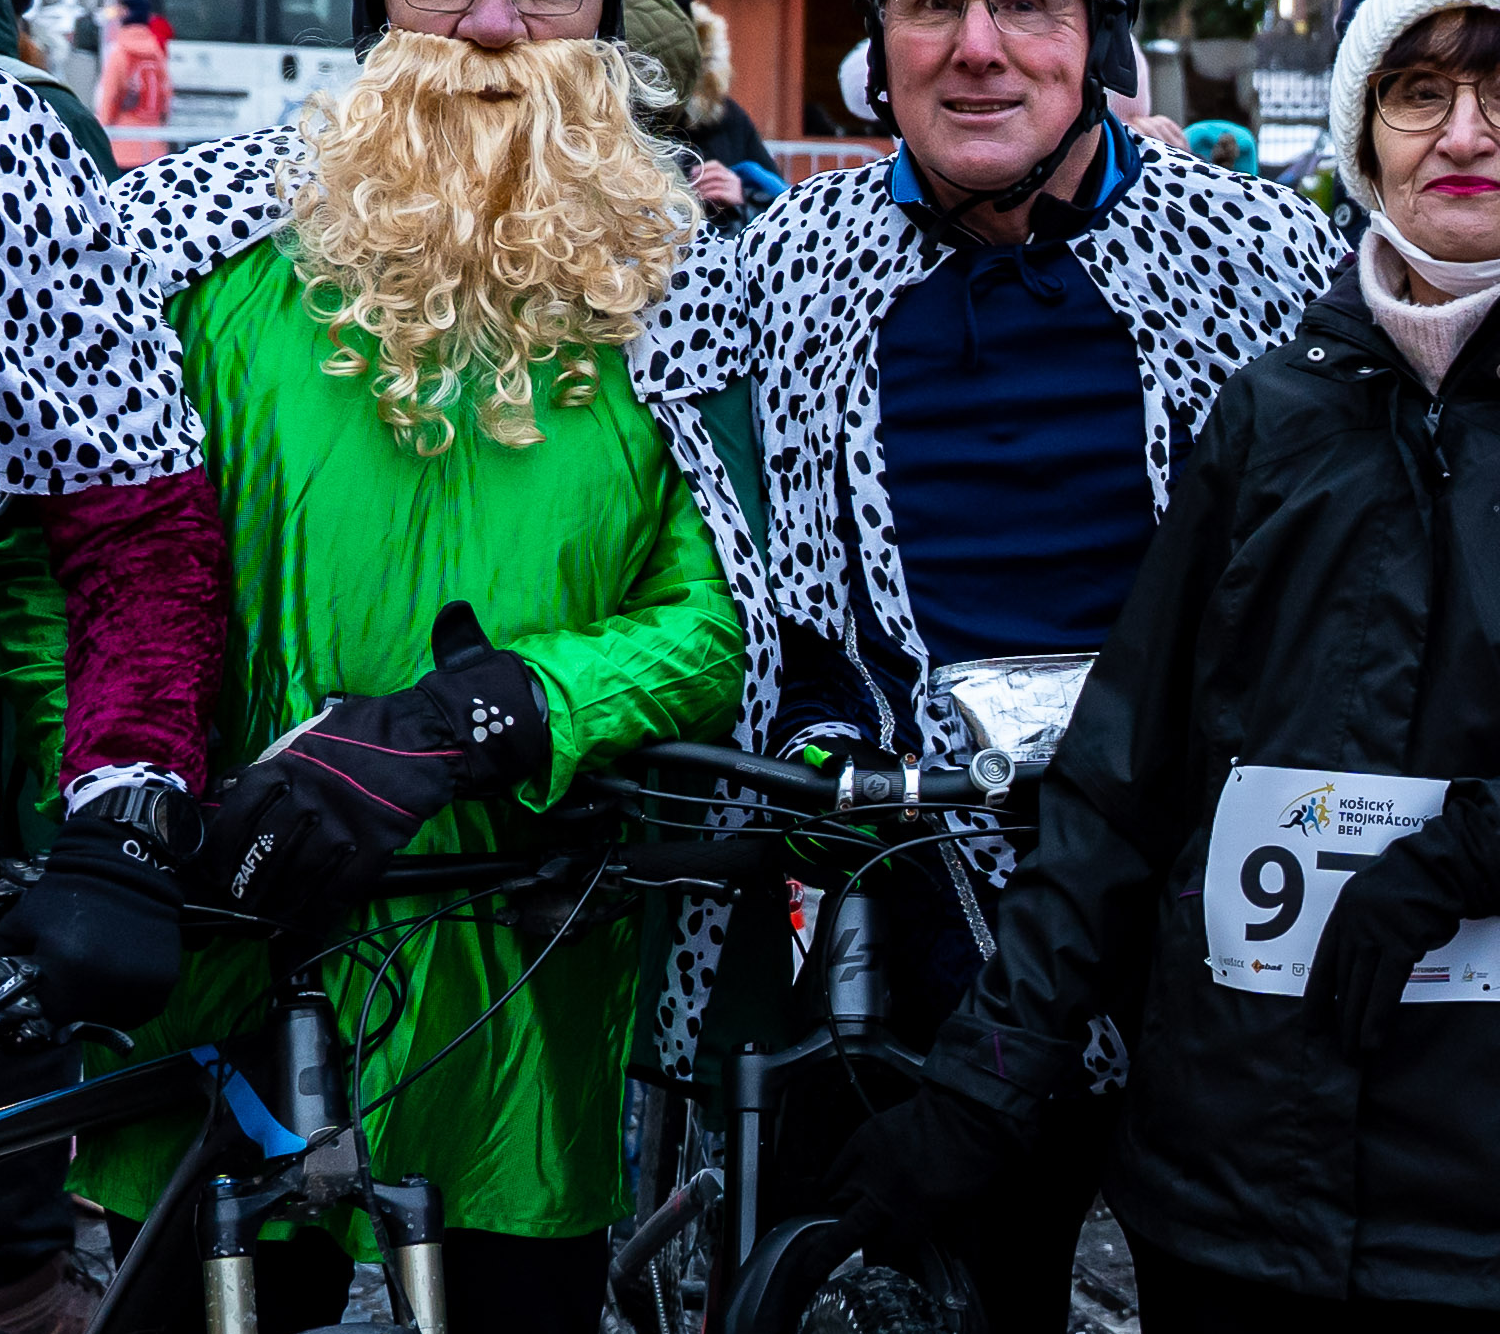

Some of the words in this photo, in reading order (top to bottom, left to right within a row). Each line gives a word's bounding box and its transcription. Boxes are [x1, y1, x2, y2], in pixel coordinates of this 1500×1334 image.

[1339, 796, 1394, 812] KOŠICKÝ
[1338, 810, 1429, 828] TROJKRÁĽOVÝ
[1337, 824, 1363, 836] BEH
[231, 842, 263, 899] CRAFT
